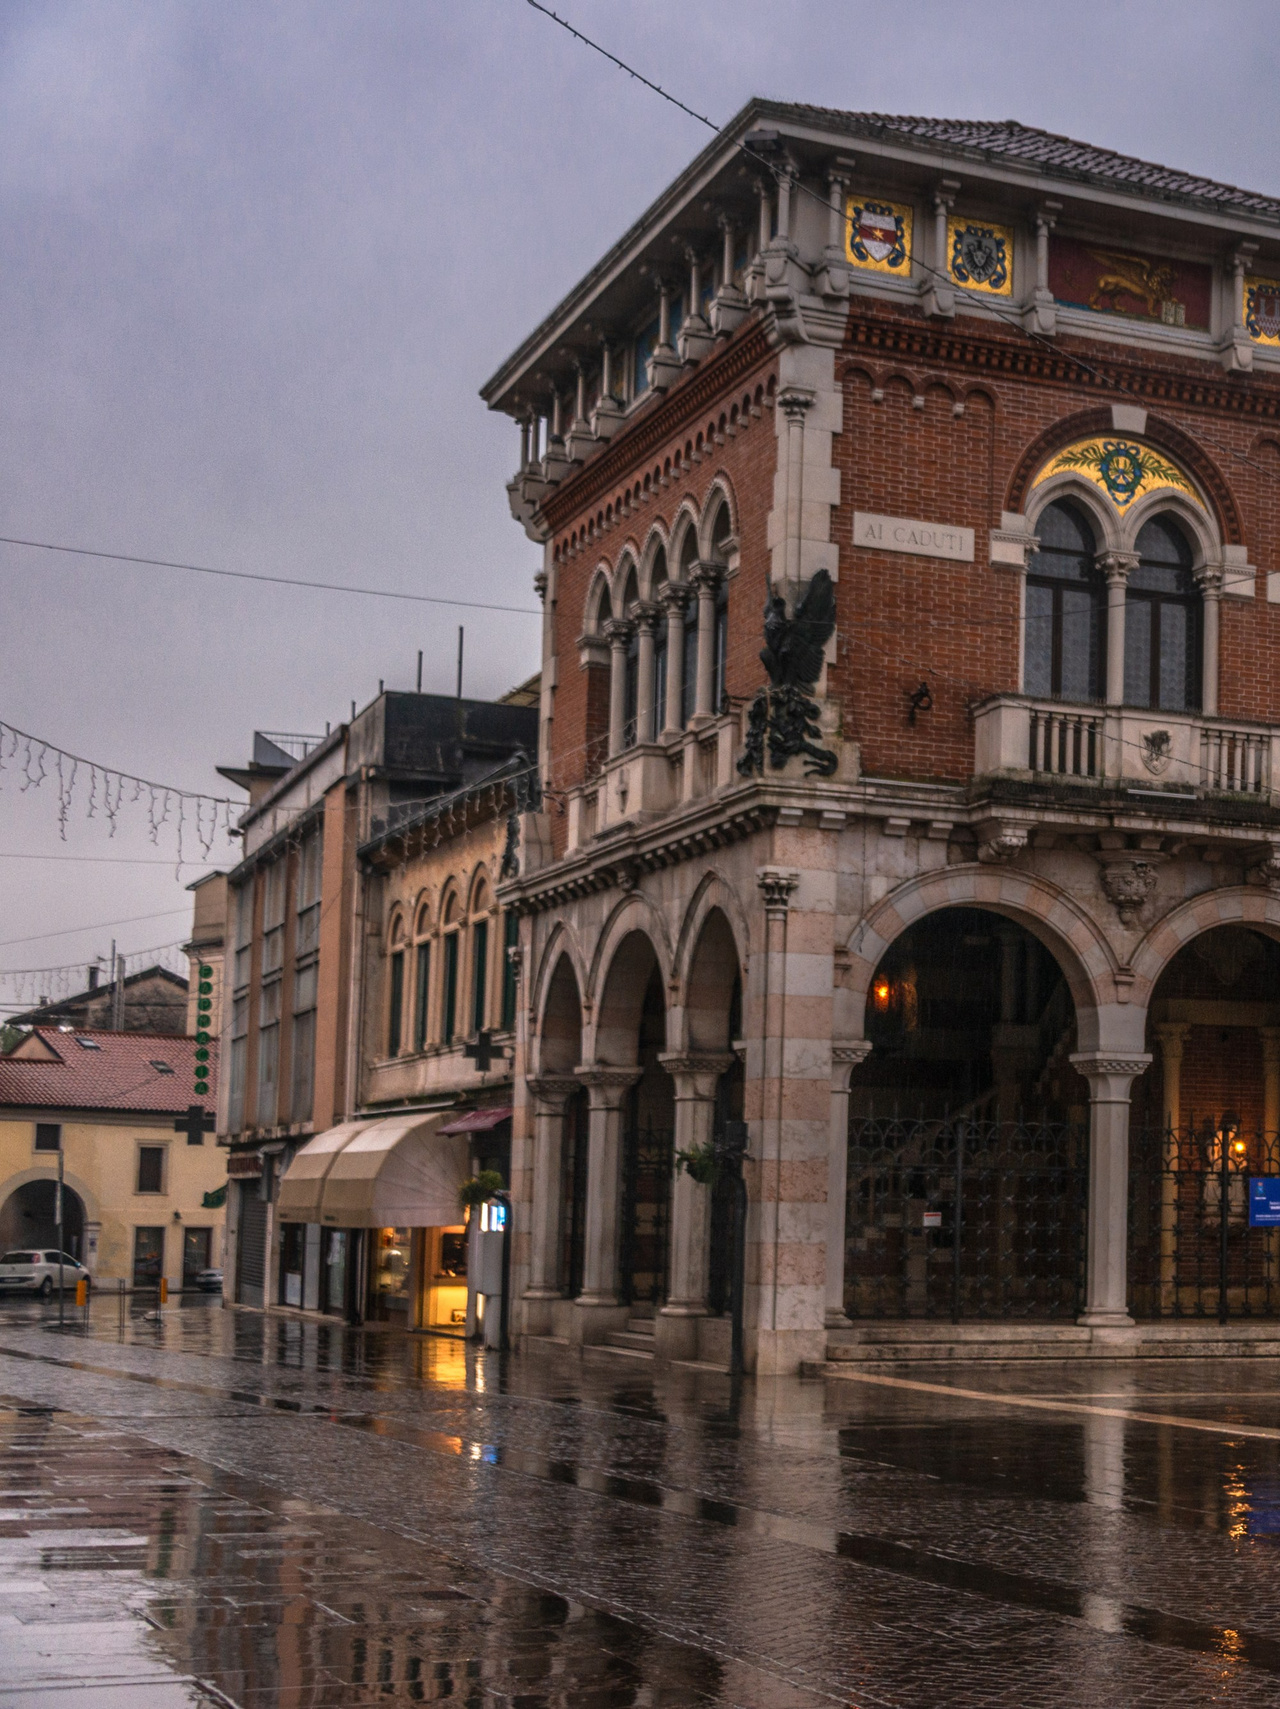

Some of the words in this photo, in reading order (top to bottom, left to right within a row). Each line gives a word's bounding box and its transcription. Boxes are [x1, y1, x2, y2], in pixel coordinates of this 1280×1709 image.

[864, 523, 883, 540] AI
[893, 527, 963, 551] CADUTI
[195, 965, 213, 1095] FARMACIA
